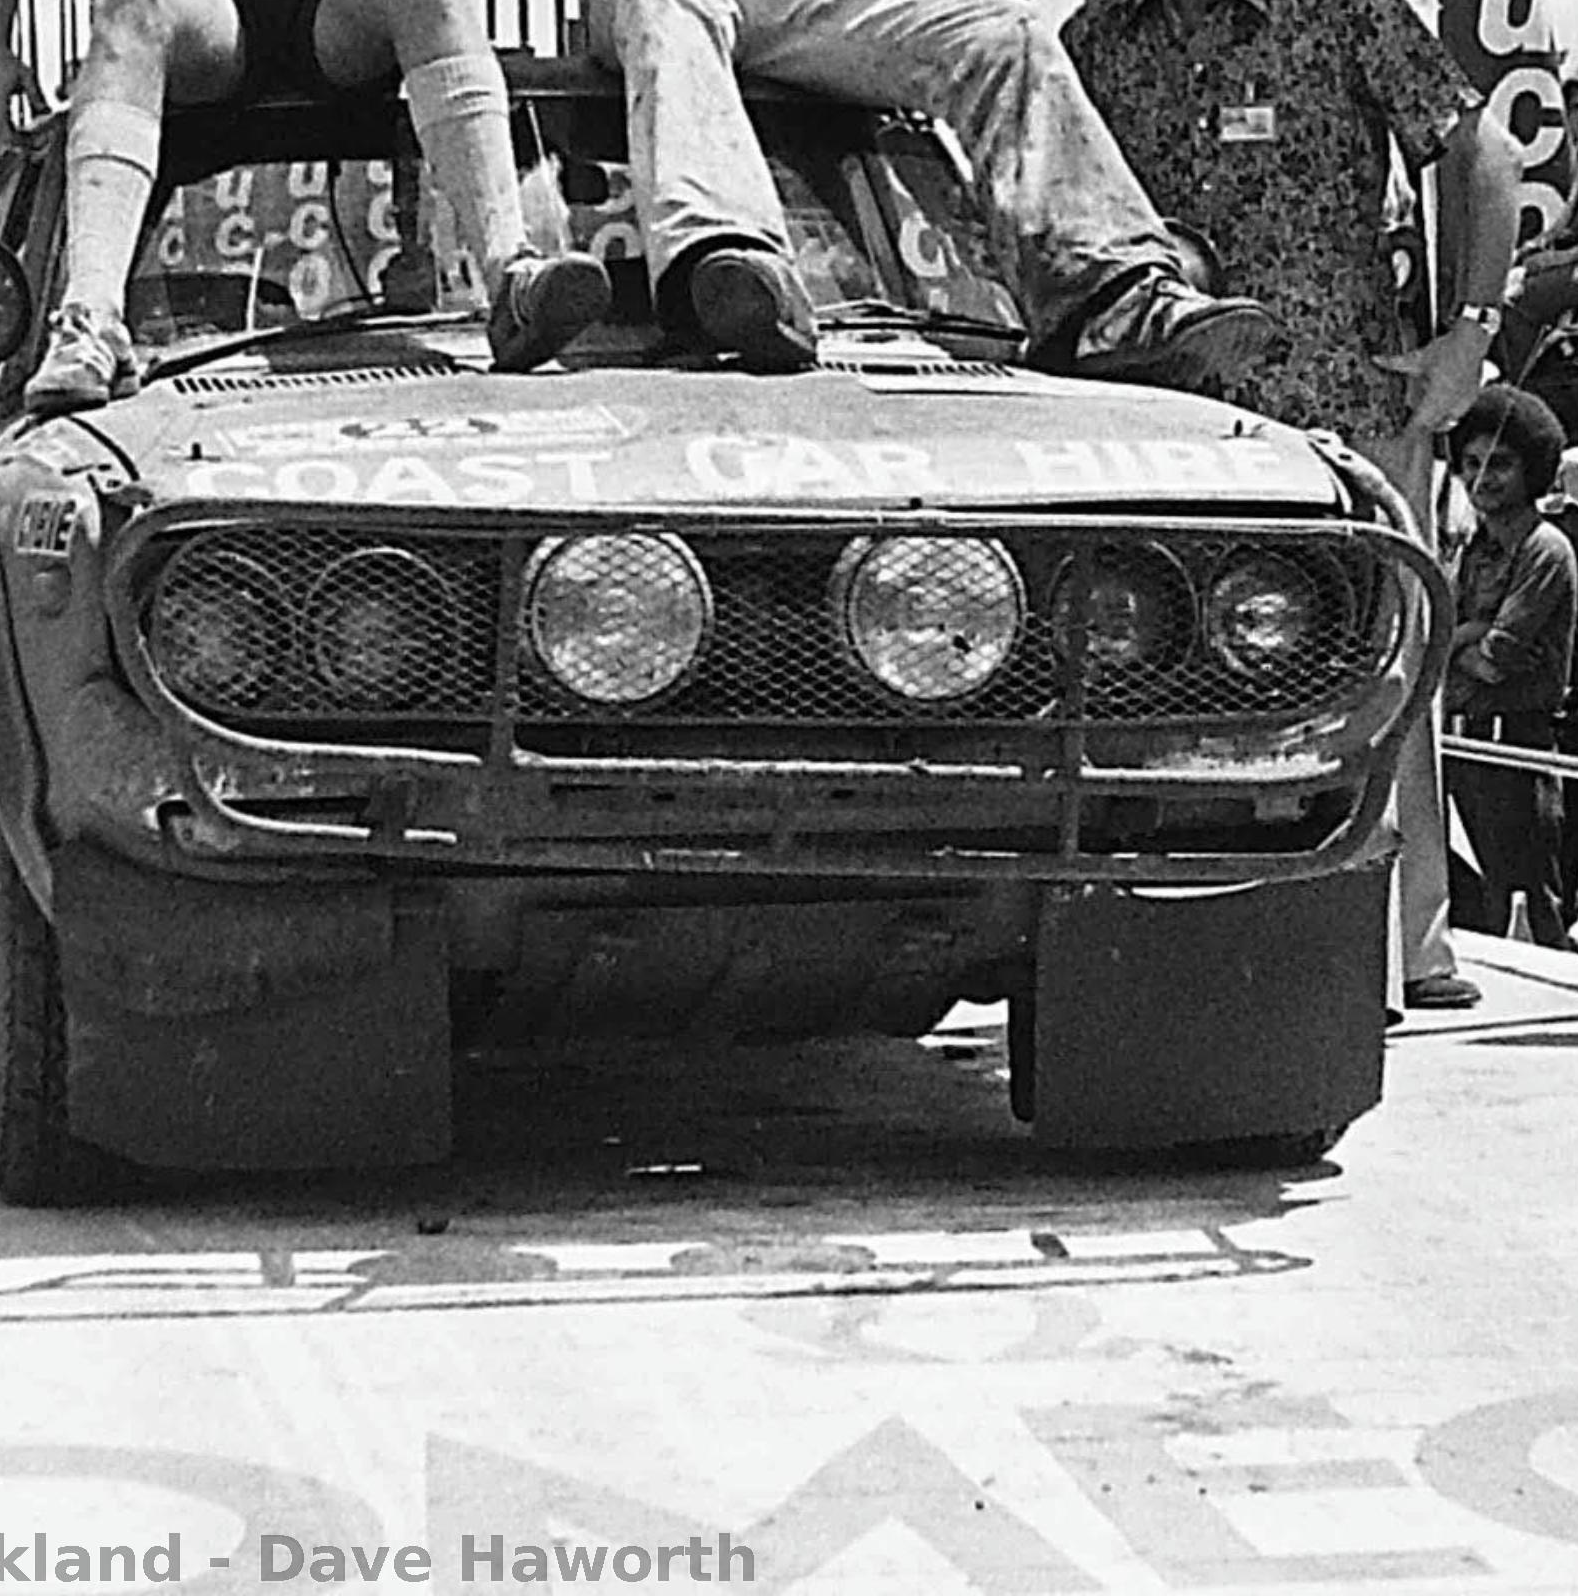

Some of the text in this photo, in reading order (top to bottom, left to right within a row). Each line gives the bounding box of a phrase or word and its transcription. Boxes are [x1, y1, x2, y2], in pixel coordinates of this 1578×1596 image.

[184, 431, 1285, 503] COAST CAR HIRE
